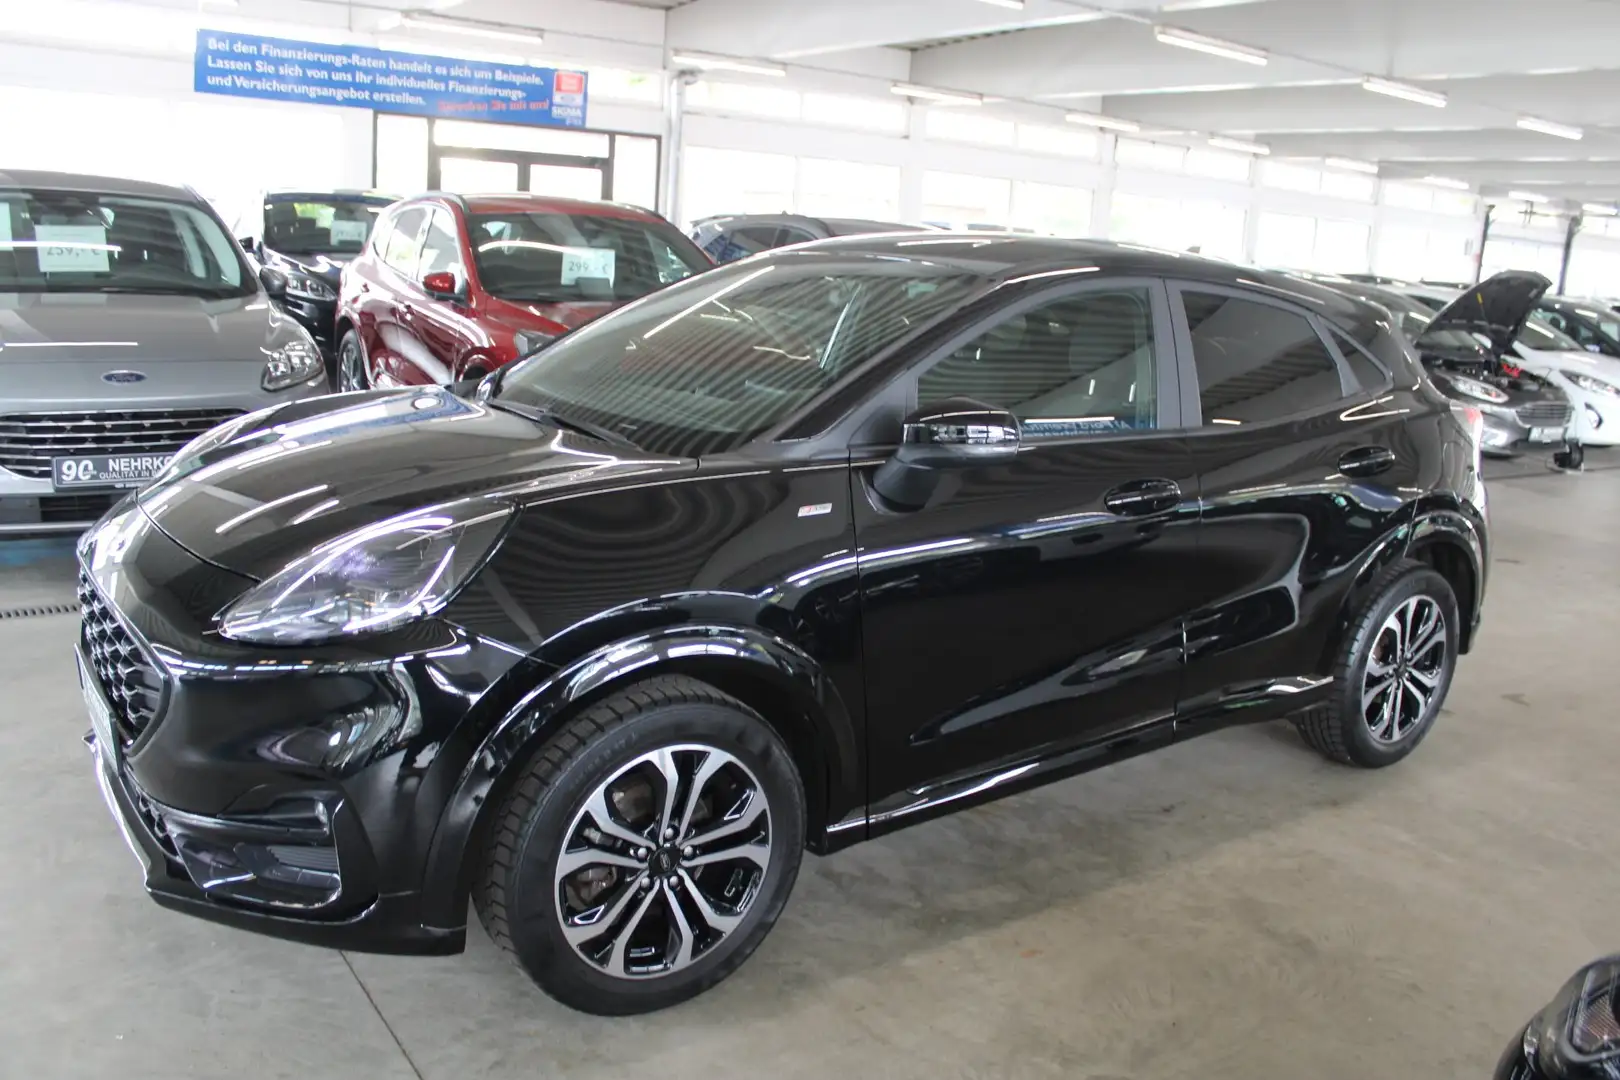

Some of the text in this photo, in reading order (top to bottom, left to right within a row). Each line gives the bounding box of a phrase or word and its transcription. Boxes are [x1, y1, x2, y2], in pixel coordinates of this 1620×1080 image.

[207, 37, 229, 51] Bei
[232, 40, 258, 55] den
[261, 43, 386, 70] Finanzierungs-Raten
[389, 57, 432, 74] handelt
[435, 66, 448, 77] es
[450, 66, 471, 79] sich
[474, 71, 493, 81] um
[494, 70, 544, 86] Beispiele.
[207, 55, 527, 101] Lassen Sie sich von uns Ihr individuelles Finanzierungs-
[207, 74, 426, 105] und Versicherungsangebot erstellen.
[61, 460, 93, 480] 90
